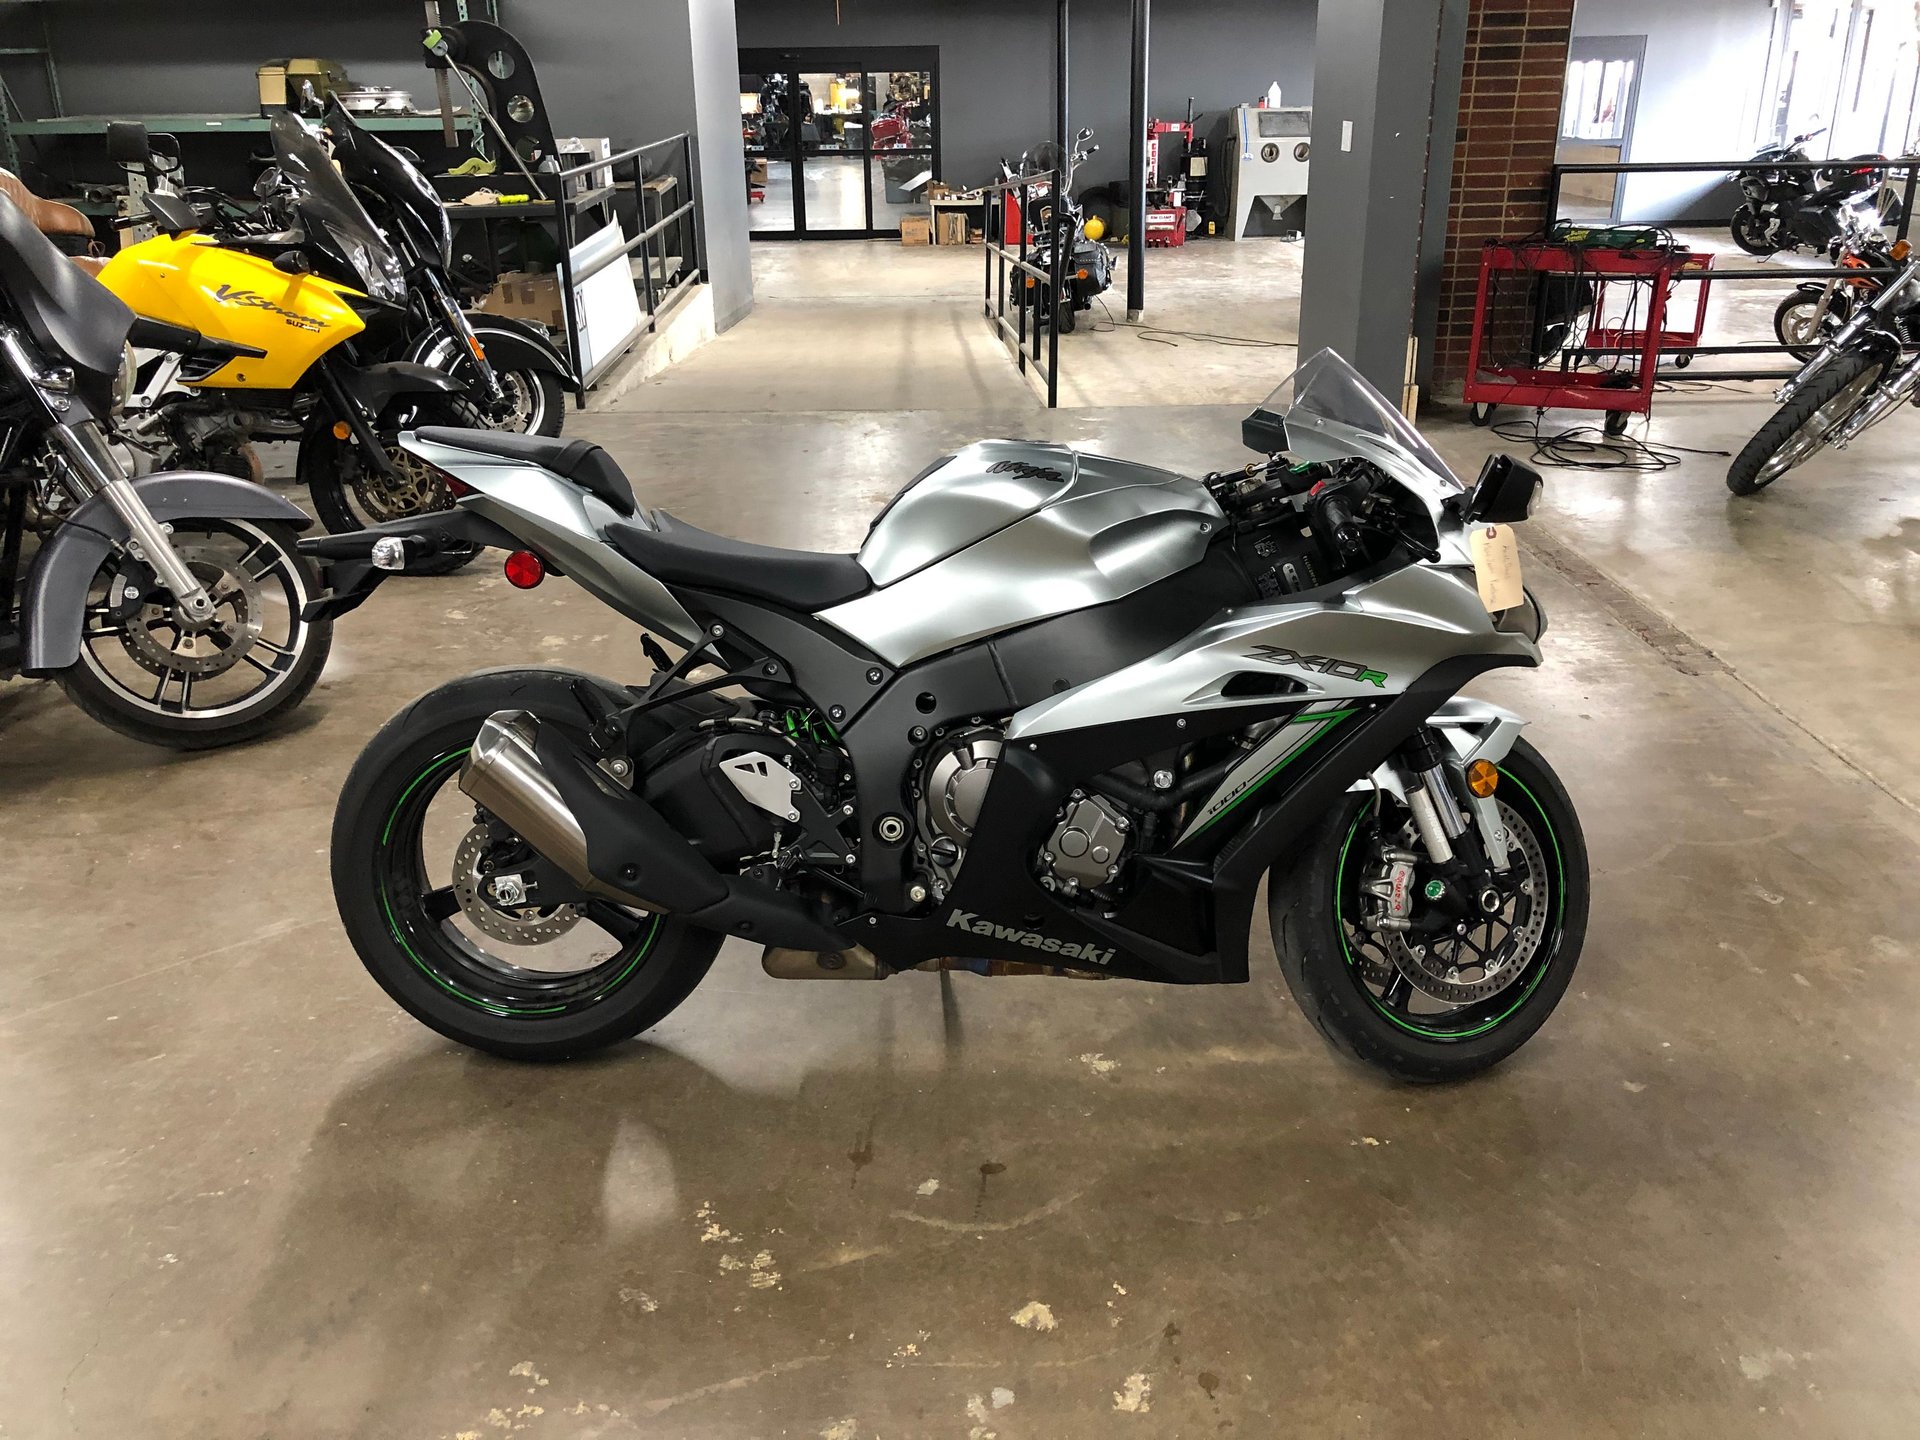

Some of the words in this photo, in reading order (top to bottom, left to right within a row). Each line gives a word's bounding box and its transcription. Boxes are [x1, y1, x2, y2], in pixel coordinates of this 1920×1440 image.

[285, 318, 321, 334] SUZI
[986, 460, 1065, 483] Ninja
[1207, 780, 1247, 816] 1000
[946, 908, 1117, 966] Kawasaki
